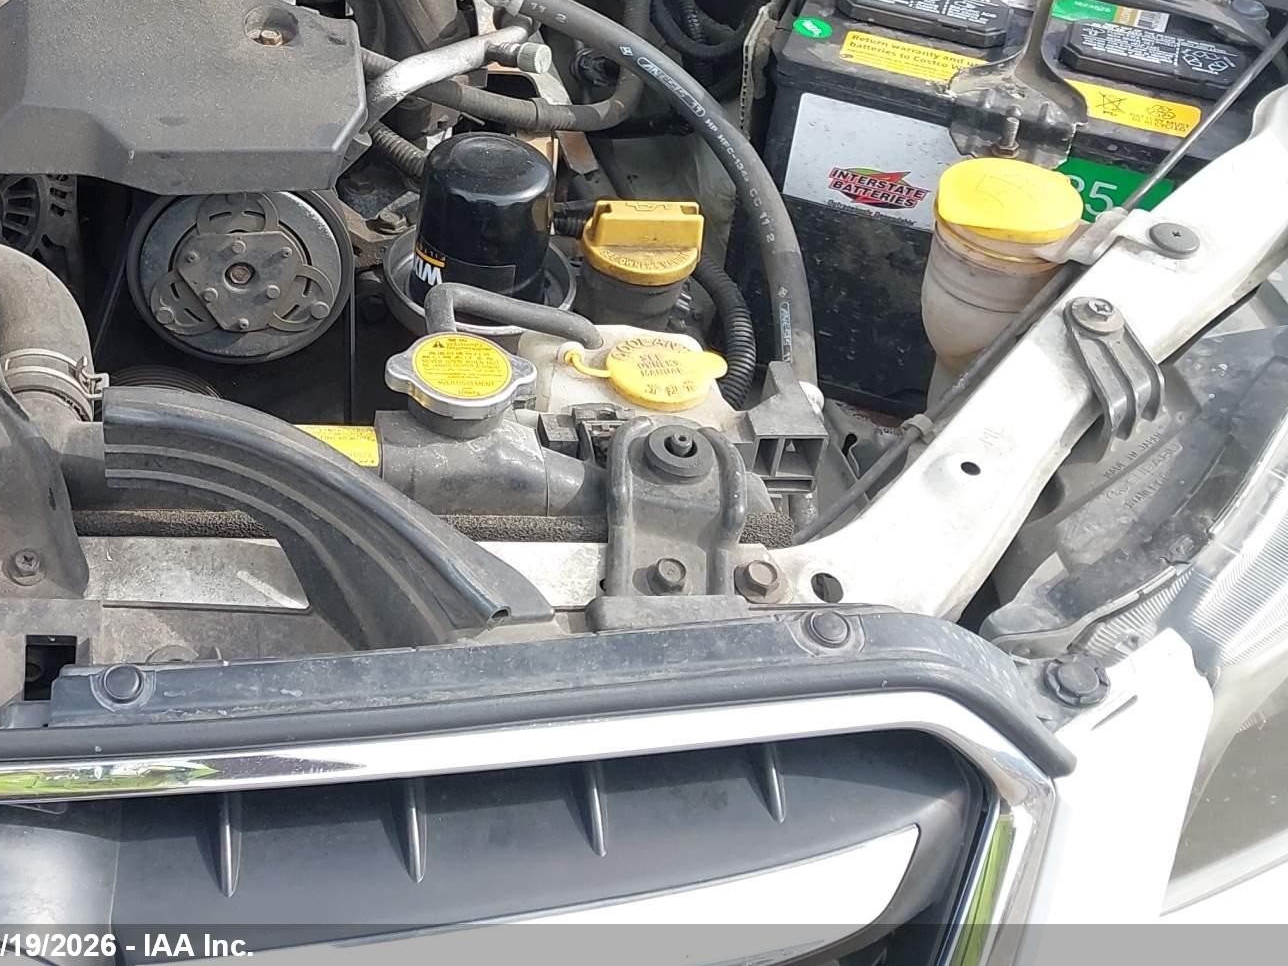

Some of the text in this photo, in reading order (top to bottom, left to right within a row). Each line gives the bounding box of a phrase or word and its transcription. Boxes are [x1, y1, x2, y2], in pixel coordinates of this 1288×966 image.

[849, 41, 897, 58] batteries
[900, 51, 910, 60] to
[913, 55, 948, 69] Costco
[852, 34, 888, 48] Return
[891, 43, 939, 61] warranty
[943, 53, 964, 65] and
[831, 169, 926, 199] INTERSTATE
[832, 180, 917, 207] BATTERIES
[611, 337, 692, 361] COOLANT
